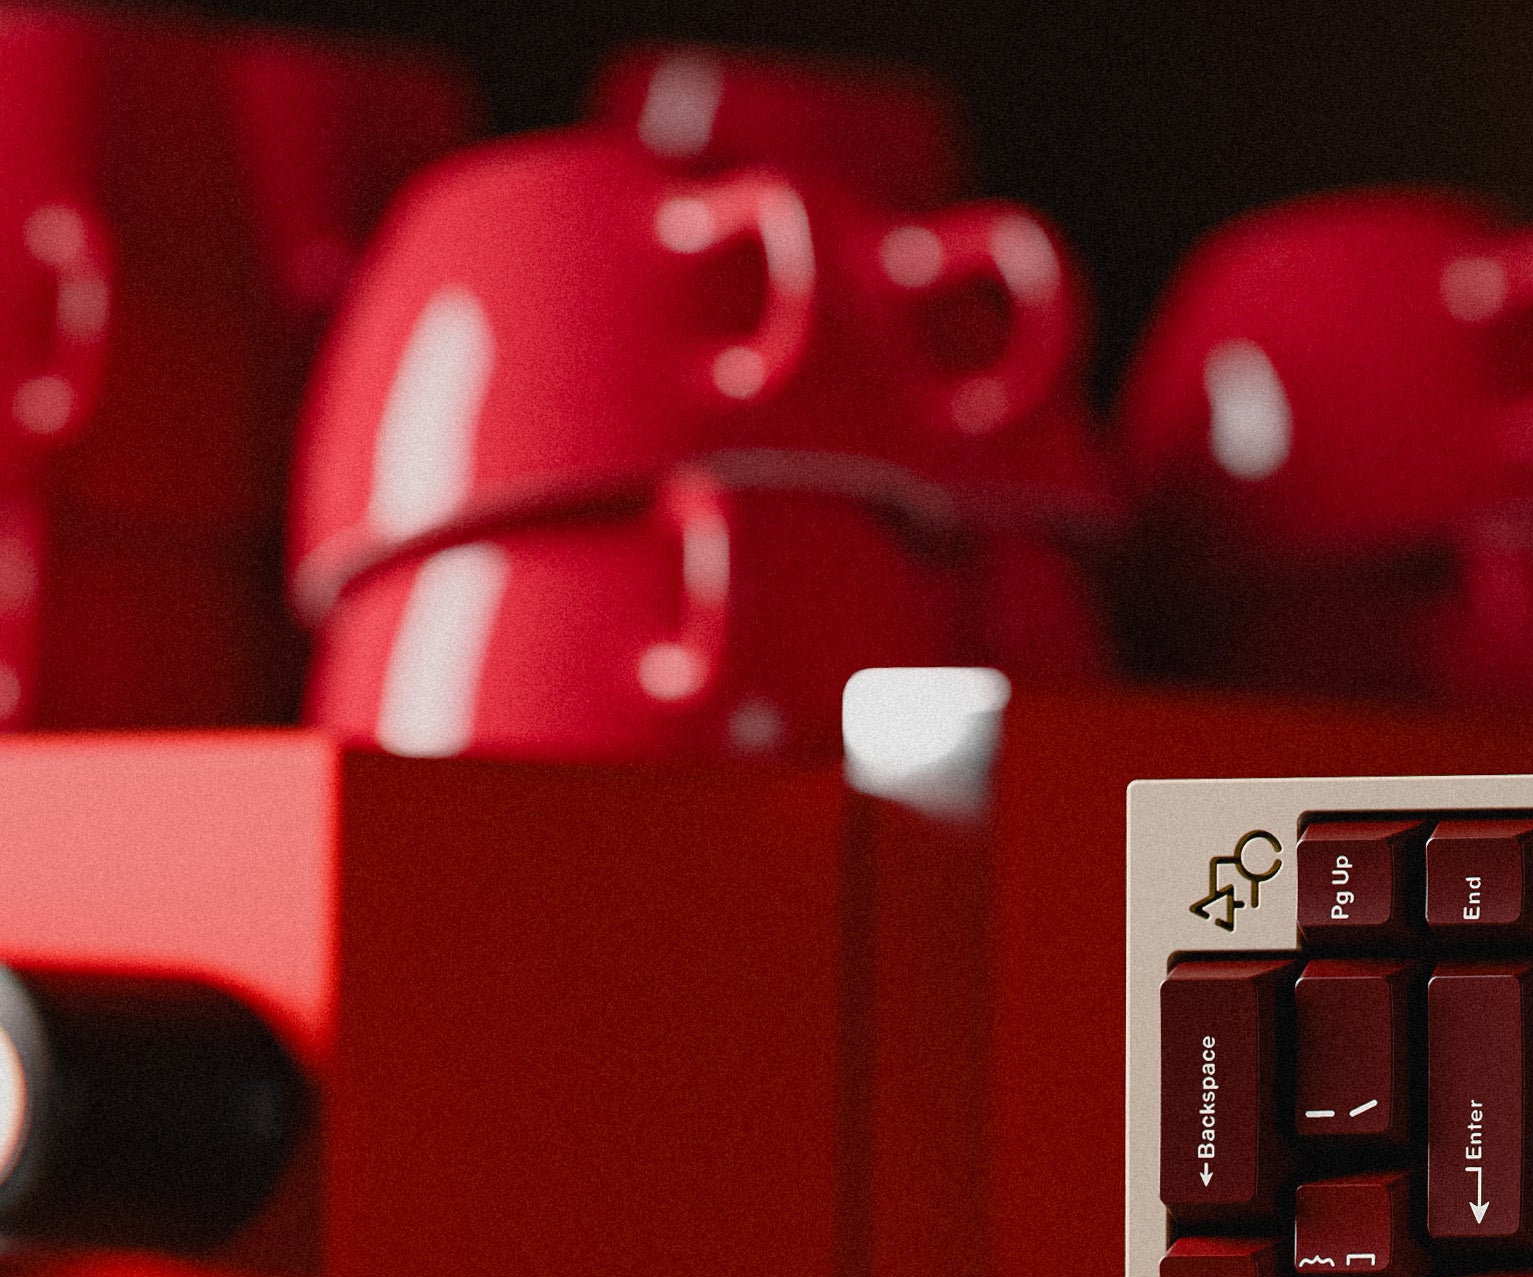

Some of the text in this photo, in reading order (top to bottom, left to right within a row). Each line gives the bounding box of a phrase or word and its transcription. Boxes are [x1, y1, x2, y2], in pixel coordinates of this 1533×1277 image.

[1330, 855, 1355, 920] Pg Up
[1462, 876, 1482, 920] End
[1197, 1035, 1219, 1159] Backspace
[1465, 1099, 1484, 1160] Enter
